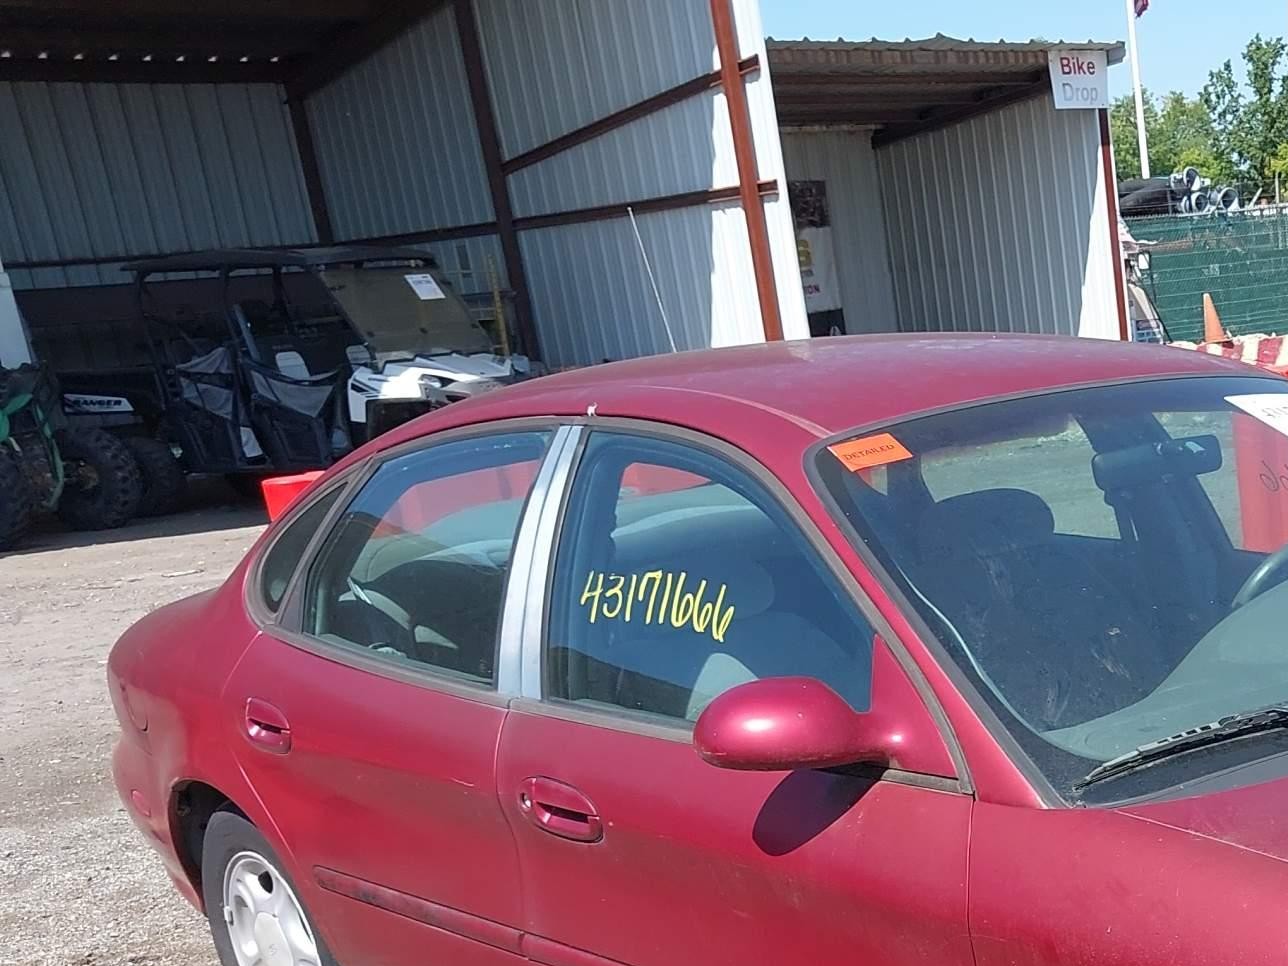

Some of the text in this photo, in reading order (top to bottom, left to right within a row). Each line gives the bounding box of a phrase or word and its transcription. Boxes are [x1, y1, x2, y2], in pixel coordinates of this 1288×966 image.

[1060, 56, 1096, 75] Bike
[1062, 82, 1098, 105] Drop
[843, 444, 895, 461] DETAILED
[580, 570, 734, 643] 43171666
